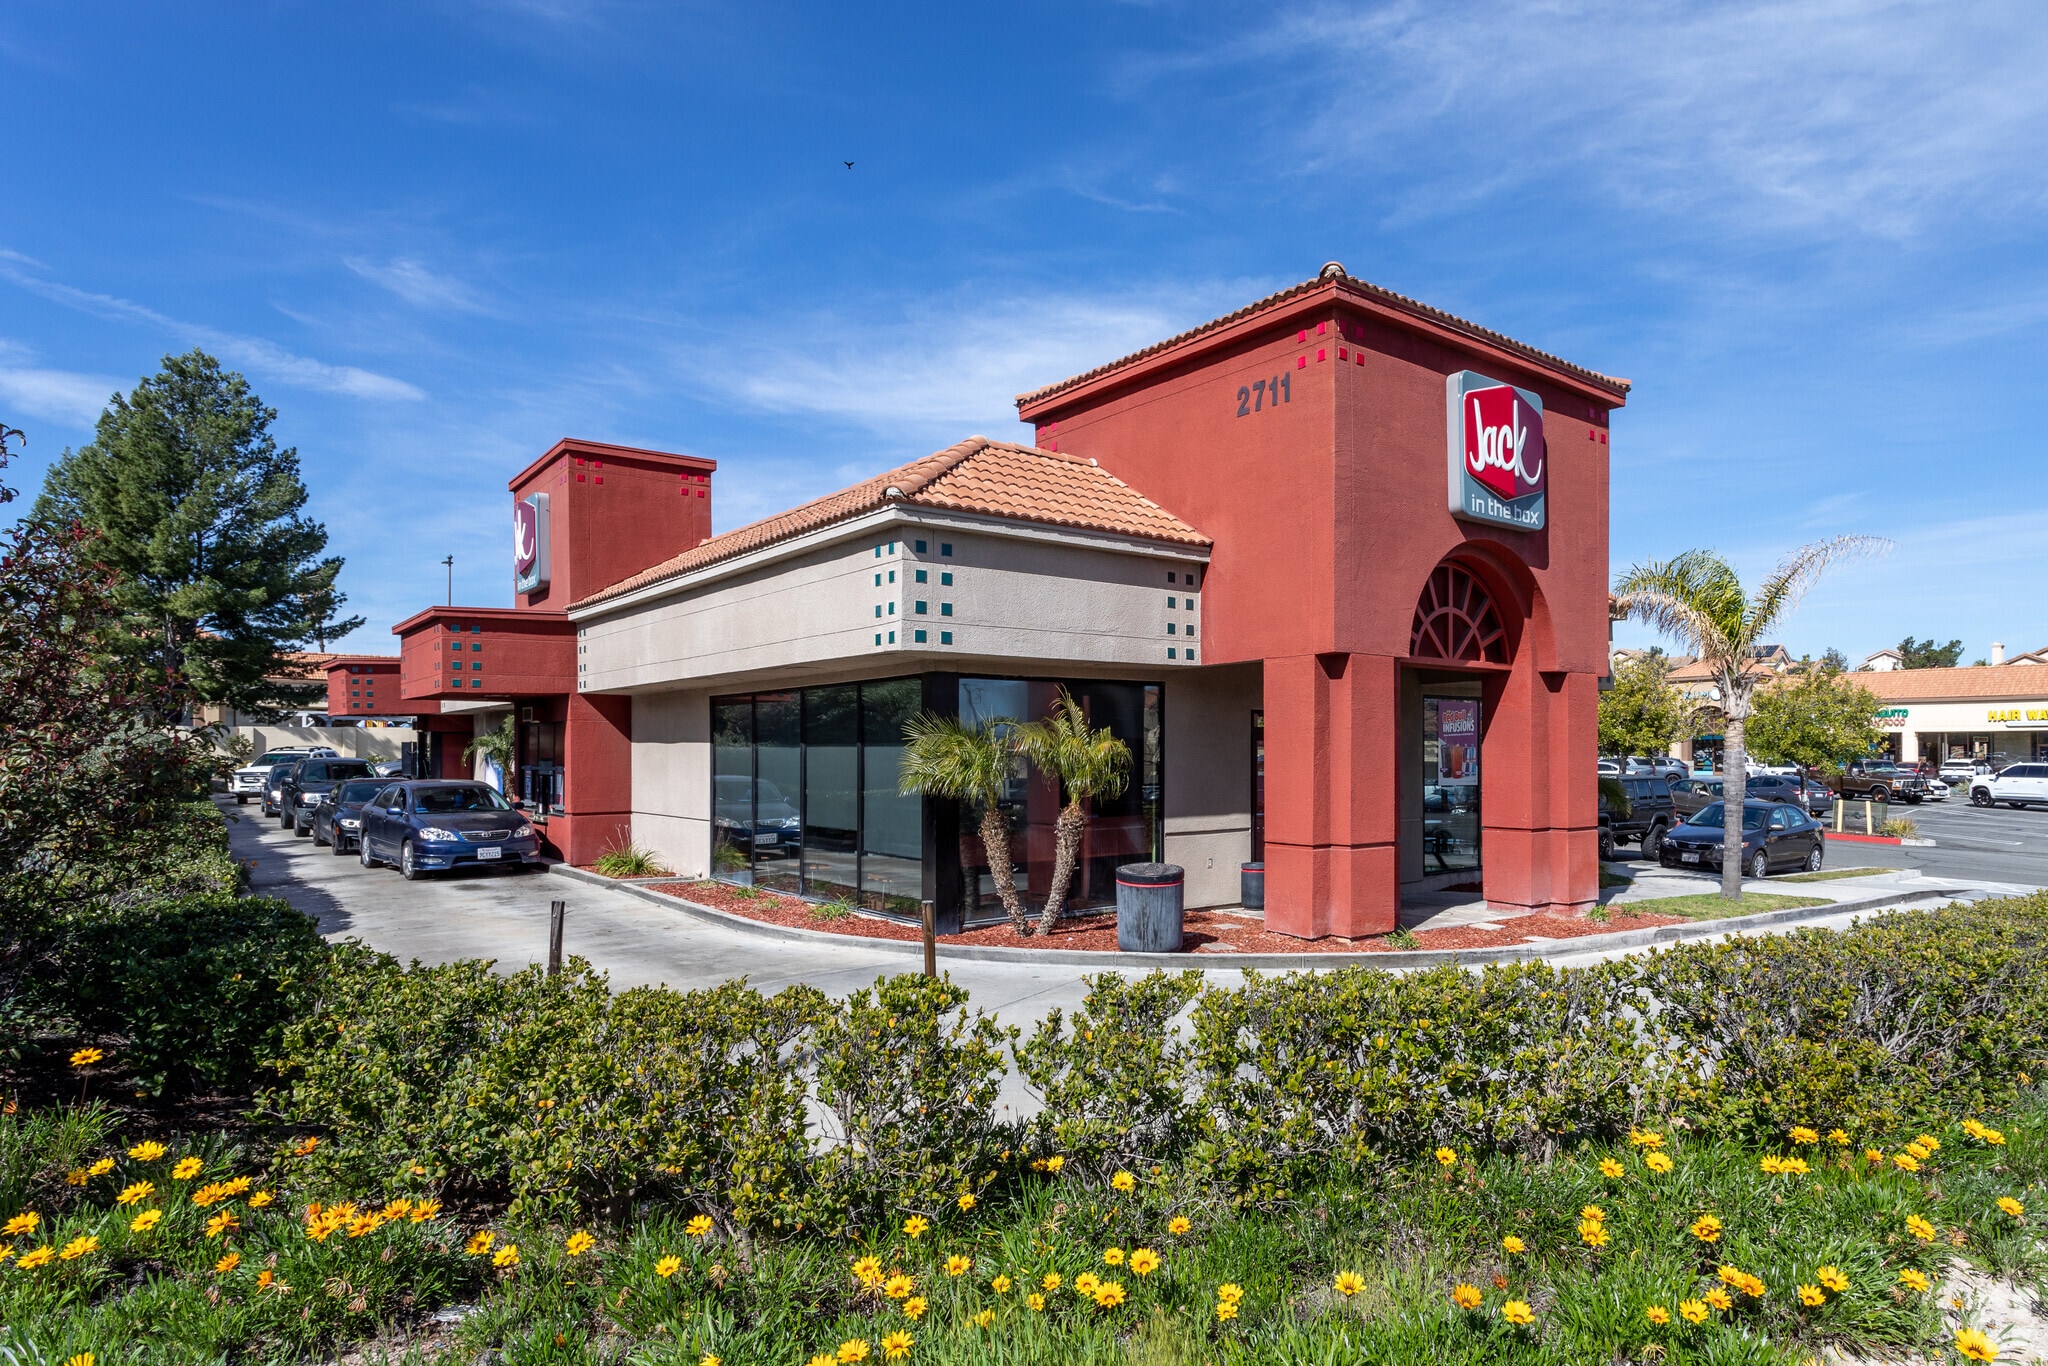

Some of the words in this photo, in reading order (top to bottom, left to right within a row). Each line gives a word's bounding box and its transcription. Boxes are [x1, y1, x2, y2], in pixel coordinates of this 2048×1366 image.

[1237, 371, 1291, 418] 2711
[1469, 398, 1542, 486] Jack
[1471, 494, 1485, 514] in
[1487, 497, 1511, 519] the
[1513, 504, 1540, 525] box
[1442, 711, 1454, 722] Red
[1454, 709, 1466, 721] Bull
[1988, 709, 2021, 722] HAIR
[2026, 709, 2048, 721] WA
[1442, 720, 1475, 732] INFUSIONS
[1882, 718, 1906, 727] FOOD
